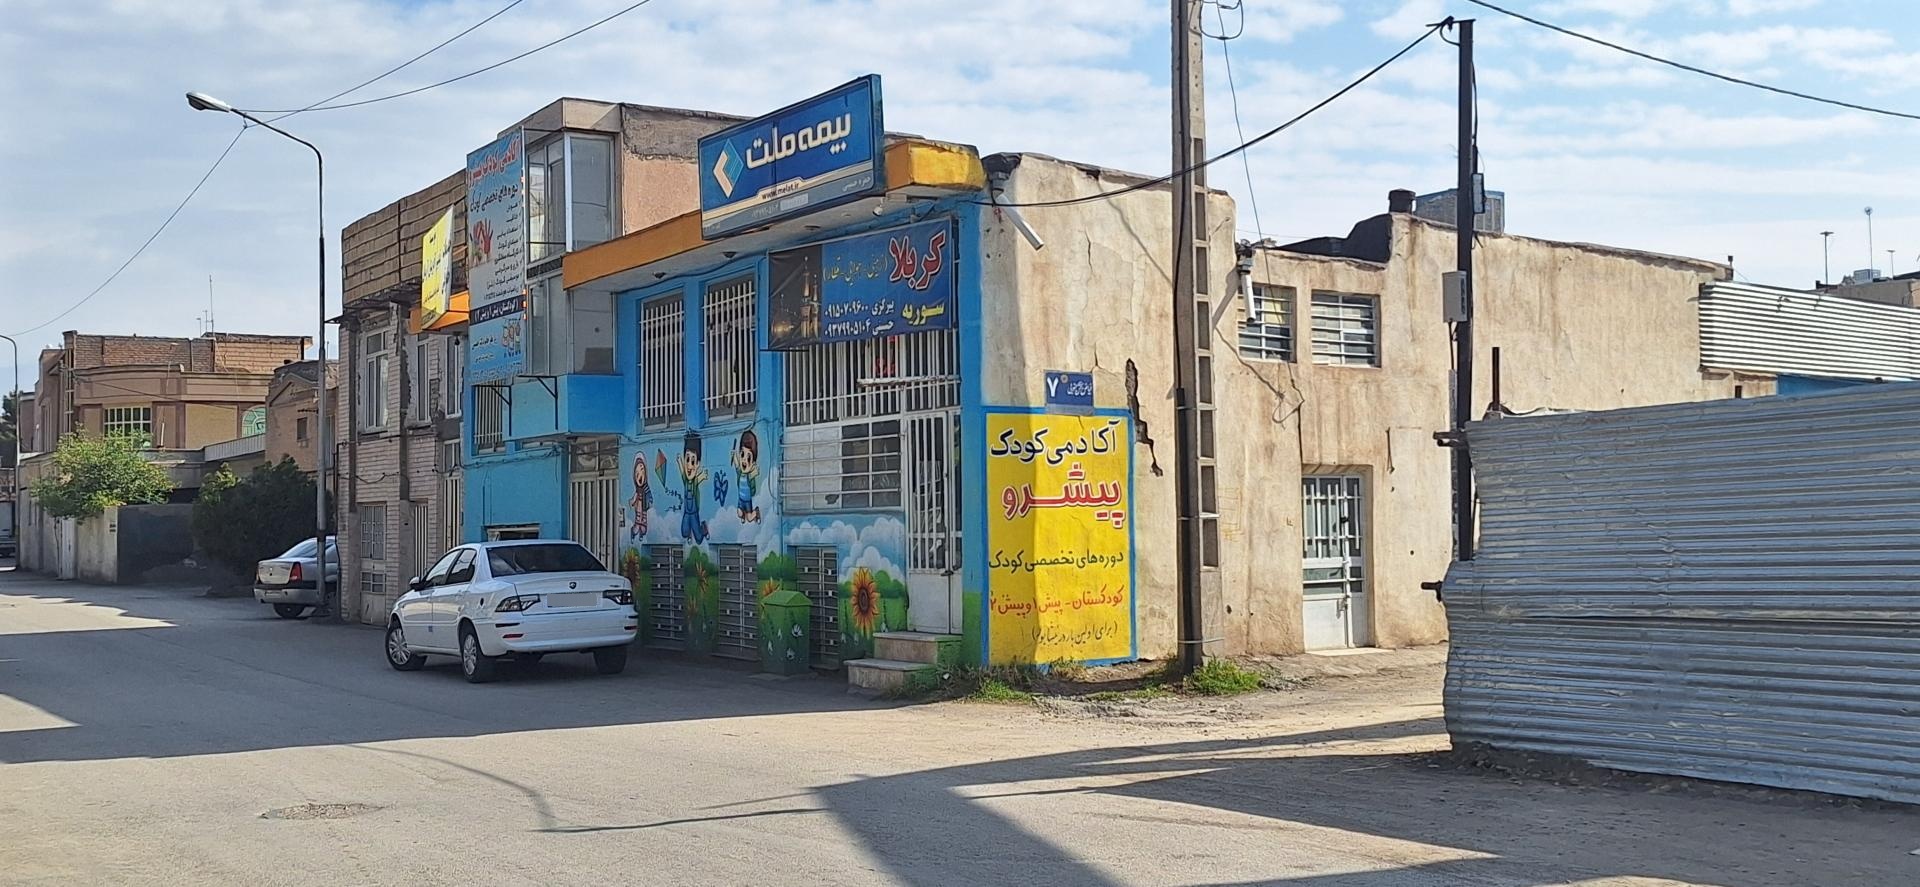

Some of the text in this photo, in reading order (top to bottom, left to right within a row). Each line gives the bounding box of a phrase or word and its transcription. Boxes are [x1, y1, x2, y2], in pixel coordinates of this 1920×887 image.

[745, 113, 851, 169] بیمه ملت
[761, 182, 800, 200] www.melat.ir
[889, 229, 946, 290] کربلا
[824, 300, 869, 318] ۰۹۱۵۰۷۰۹۶۰۰
[902, 302, 945, 326] سوریه
[824, 318, 894, 338] حسینی ۰۹۳۷۹۹۰۵۱۰۴
[1046, 376, 1059, 398] ۷
[990, 419, 1120, 465] آکادمی کودک
[1002, 462, 1125, 529] پیشرو
[988, 550, 1025, 574] کودک
[1024, 550, 1075, 572] تخصصی
[1038, 592, 1064, 616] پیش
[1071, 583, 1125, 610] کودکستان
